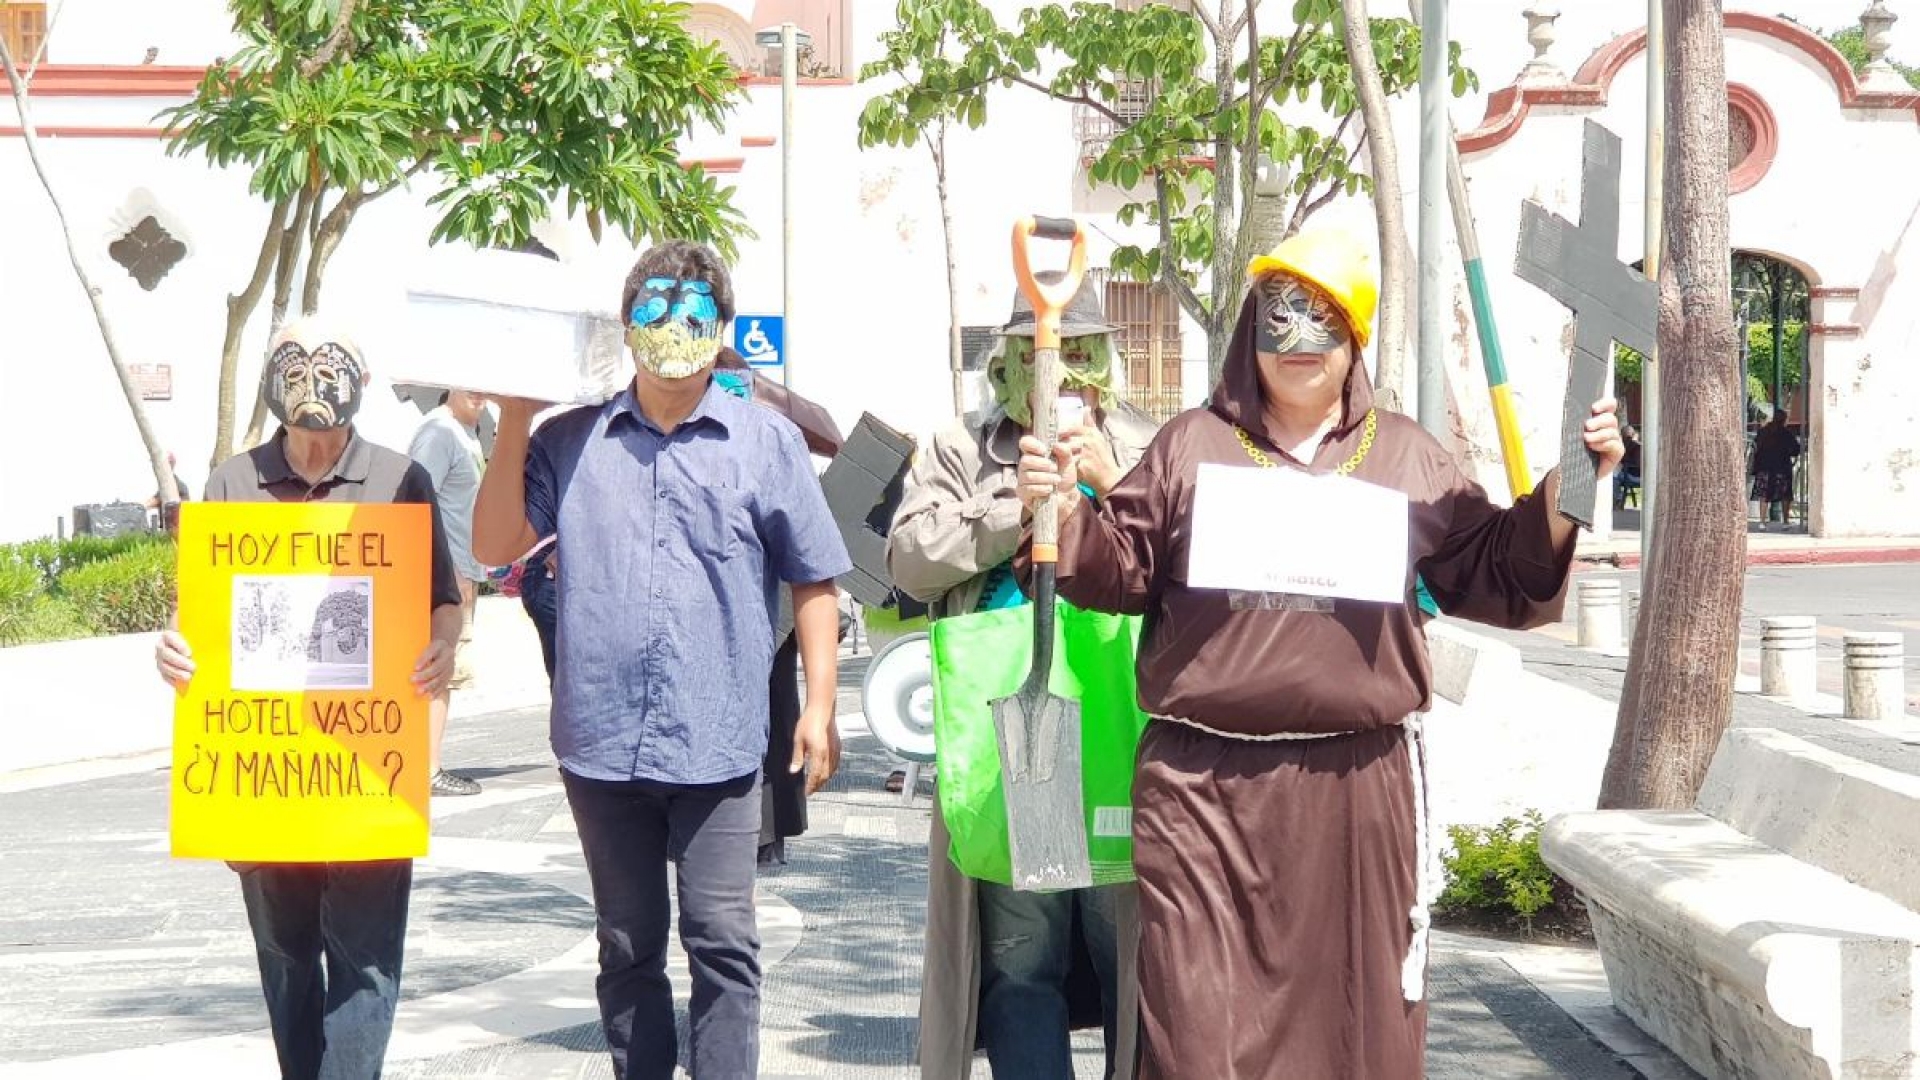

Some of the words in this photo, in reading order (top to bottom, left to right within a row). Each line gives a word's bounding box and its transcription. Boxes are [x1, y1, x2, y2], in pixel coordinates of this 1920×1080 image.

[211, 533, 280, 567] HOY
[290, 532, 352, 567] FUE
[362, 532, 393, 567] EL
[205, 698, 299, 735] HOTEL
[313, 700, 403, 736] VASCO
[183, 743, 220, 795] ¿Y
